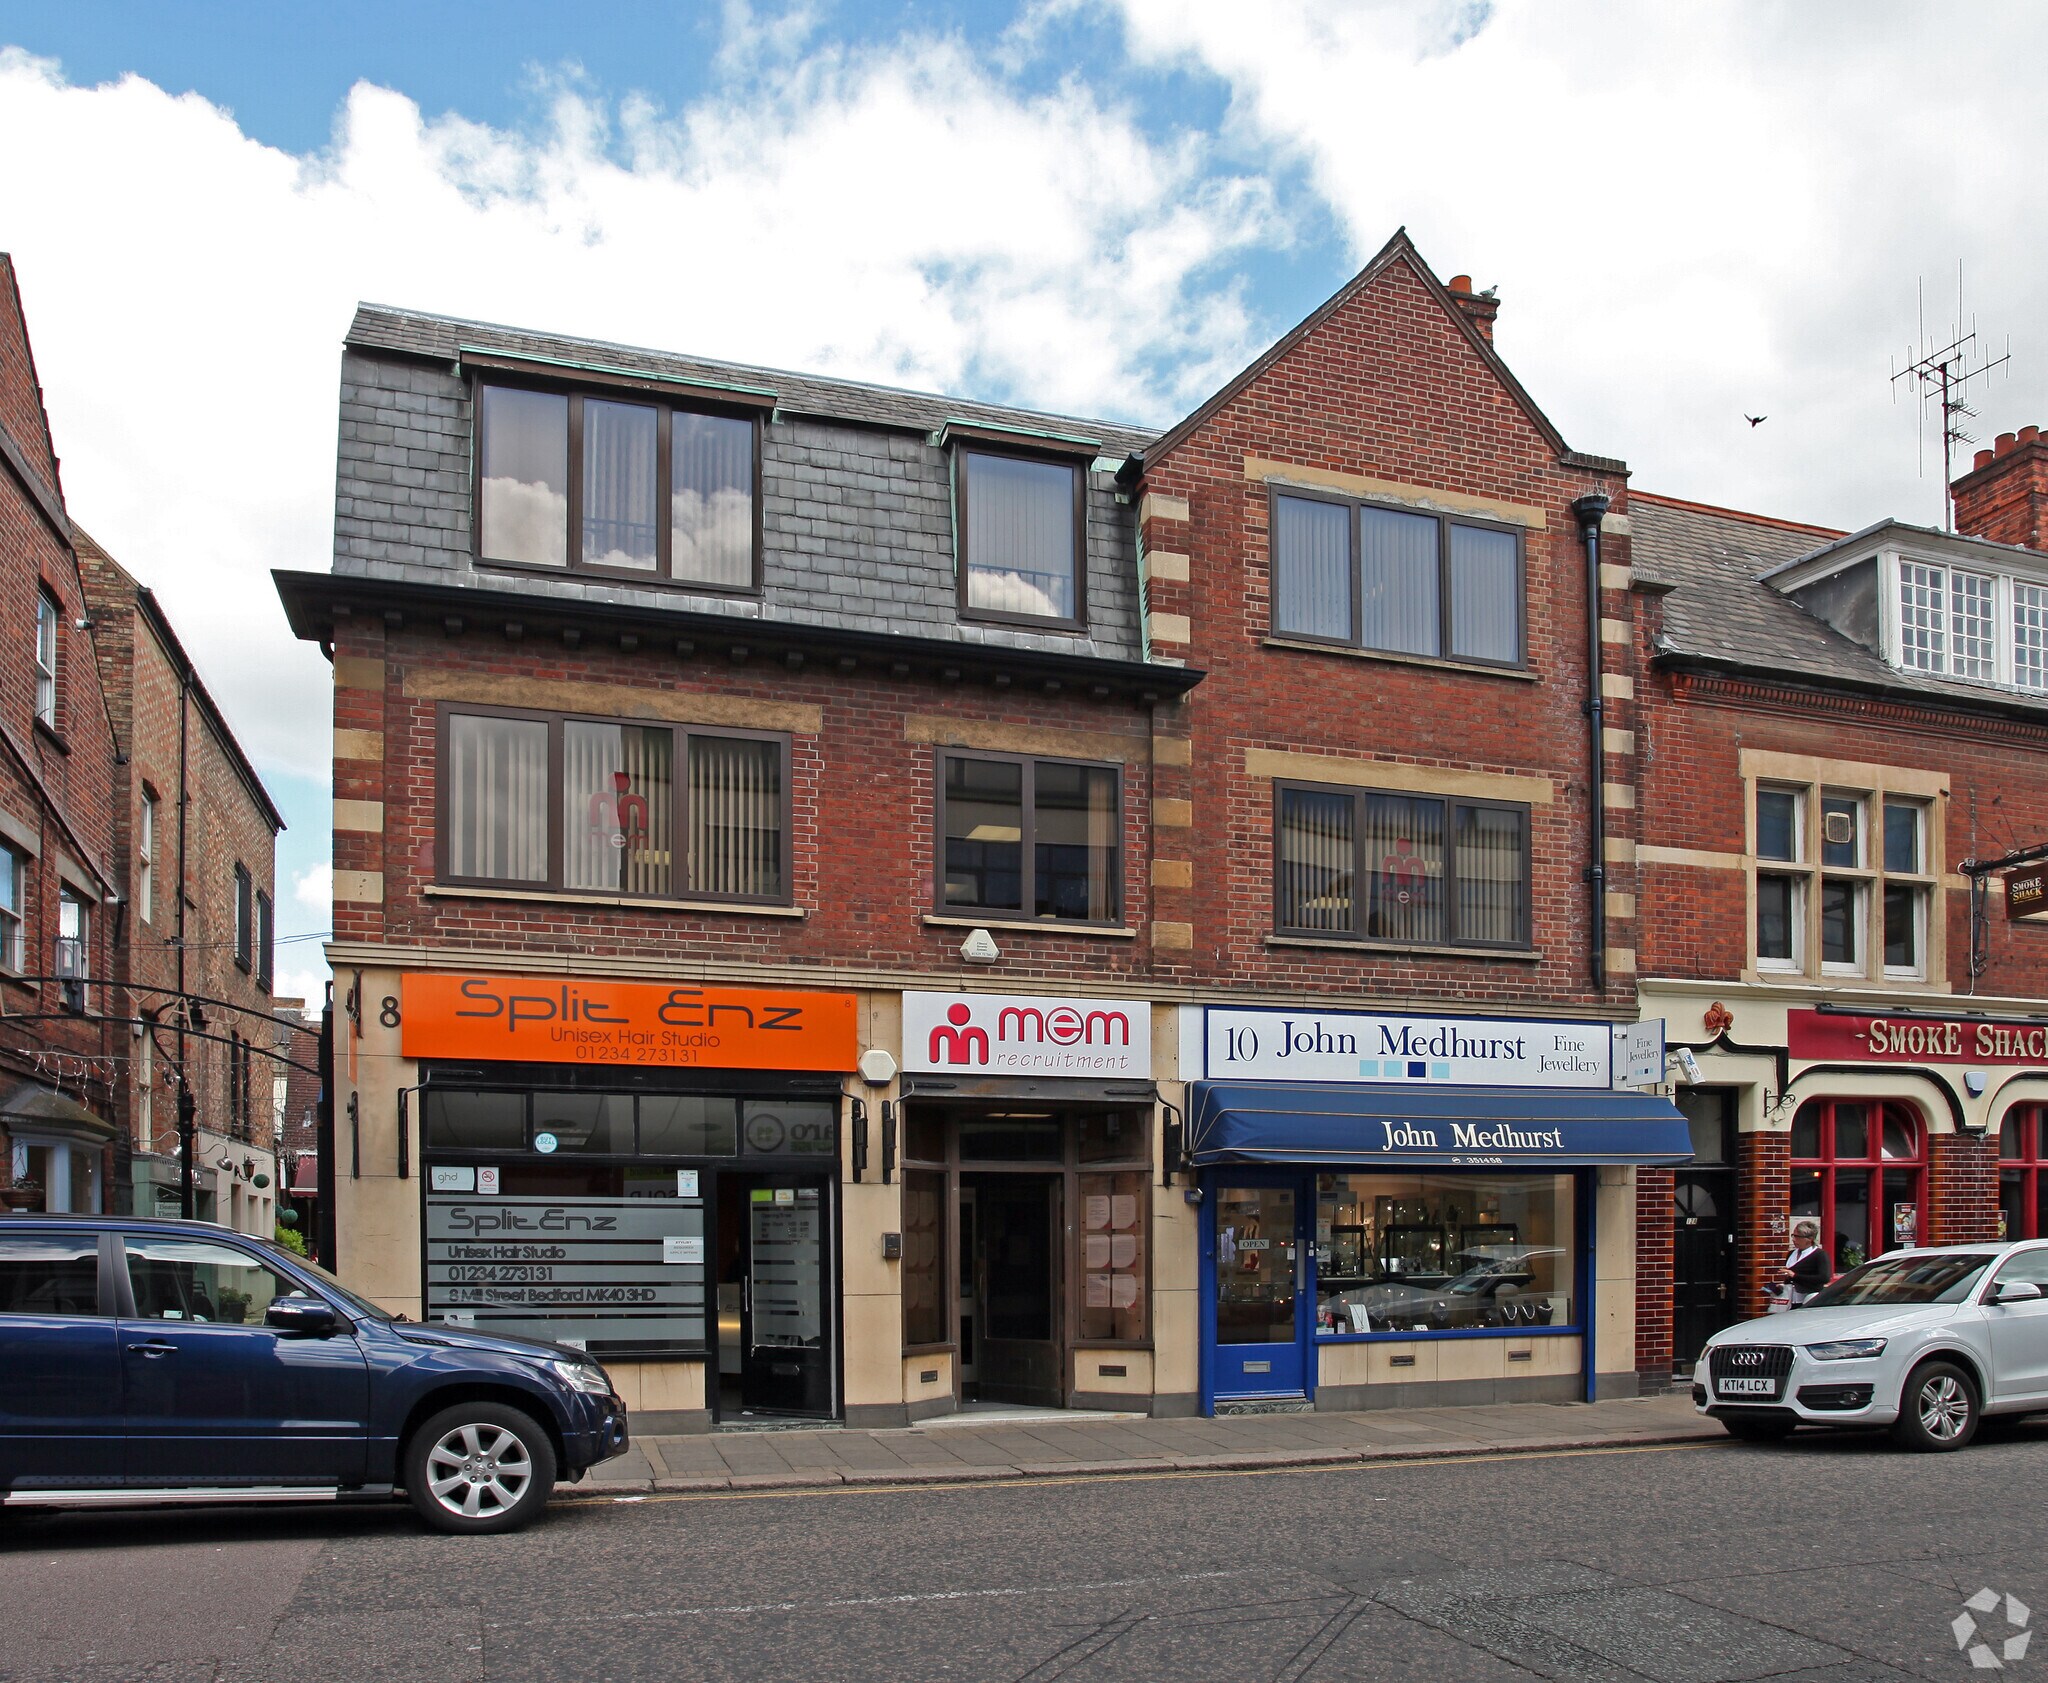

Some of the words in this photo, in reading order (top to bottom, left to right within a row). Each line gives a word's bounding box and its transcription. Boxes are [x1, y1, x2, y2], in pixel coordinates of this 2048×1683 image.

[2012, 877, 2042, 892] SMOKE
[2012, 887, 2043, 901] SHACK
[379, 995, 401, 1028] 8
[456, 979, 630, 1032] Split
[658, 989, 803, 1031] Enz
[998, 1006, 1130, 1047] mem
[551, 1026, 612, 1044] Unisex
[619, 1029, 655, 1046] Hair
[661, 1030, 721, 1049] Studio
[1225, 1026, 1259, 1062] 10
[1276, 1020, 1358, 1058] John
[1377, 1024, 1527, 1061] Medhurst
[1553, 1035, 1585, 1052] Fine
[1635, 1038, 1653, 1049] Fine
[1869, 1019, 1962, 1056] SMOKE
[1976, 1023, 2048, 1059] SHAC
[576, 1045, 631, 1061] 01234
[636, 1047, 698, 1063] 273131
[996, 1052, 1130, 1069] recruitment
[1628, 1048, 1661, 1063] Jewellery
[1537, 1055, 1601, 1076] Jewellery
[1381, 1121, 1438, 1152] John
[1450, 1123, 1565, 1149] Medhurst
[438, 1172, 458, 1184] ghd
[448, 1208, 539, 1236] Split
[539, 1208, 618, 1231] Enz
[448, 1245, 492, 1259] Unisex
[494, 1245, 522, 1259] Hair
[523, 1245, 566, 1259] Studio
[1242, 1240, 1266, 1248] OPEN
[448, 1265, 497, 1281] 01234
[499, 1266, 553, 1281] 273131
[449, 1288, 459, 1302] 8
[485, 1288, 526, 1302] Street
[528, 1288, 584, 1302] Bedford
[586, 1289, 624, 1302] MK40
[626, 1289, 657, 1302] 3HD
[1724, 1380, 1745, 1391] KT14
[1747, 1380, 1768, 1392] LCX
